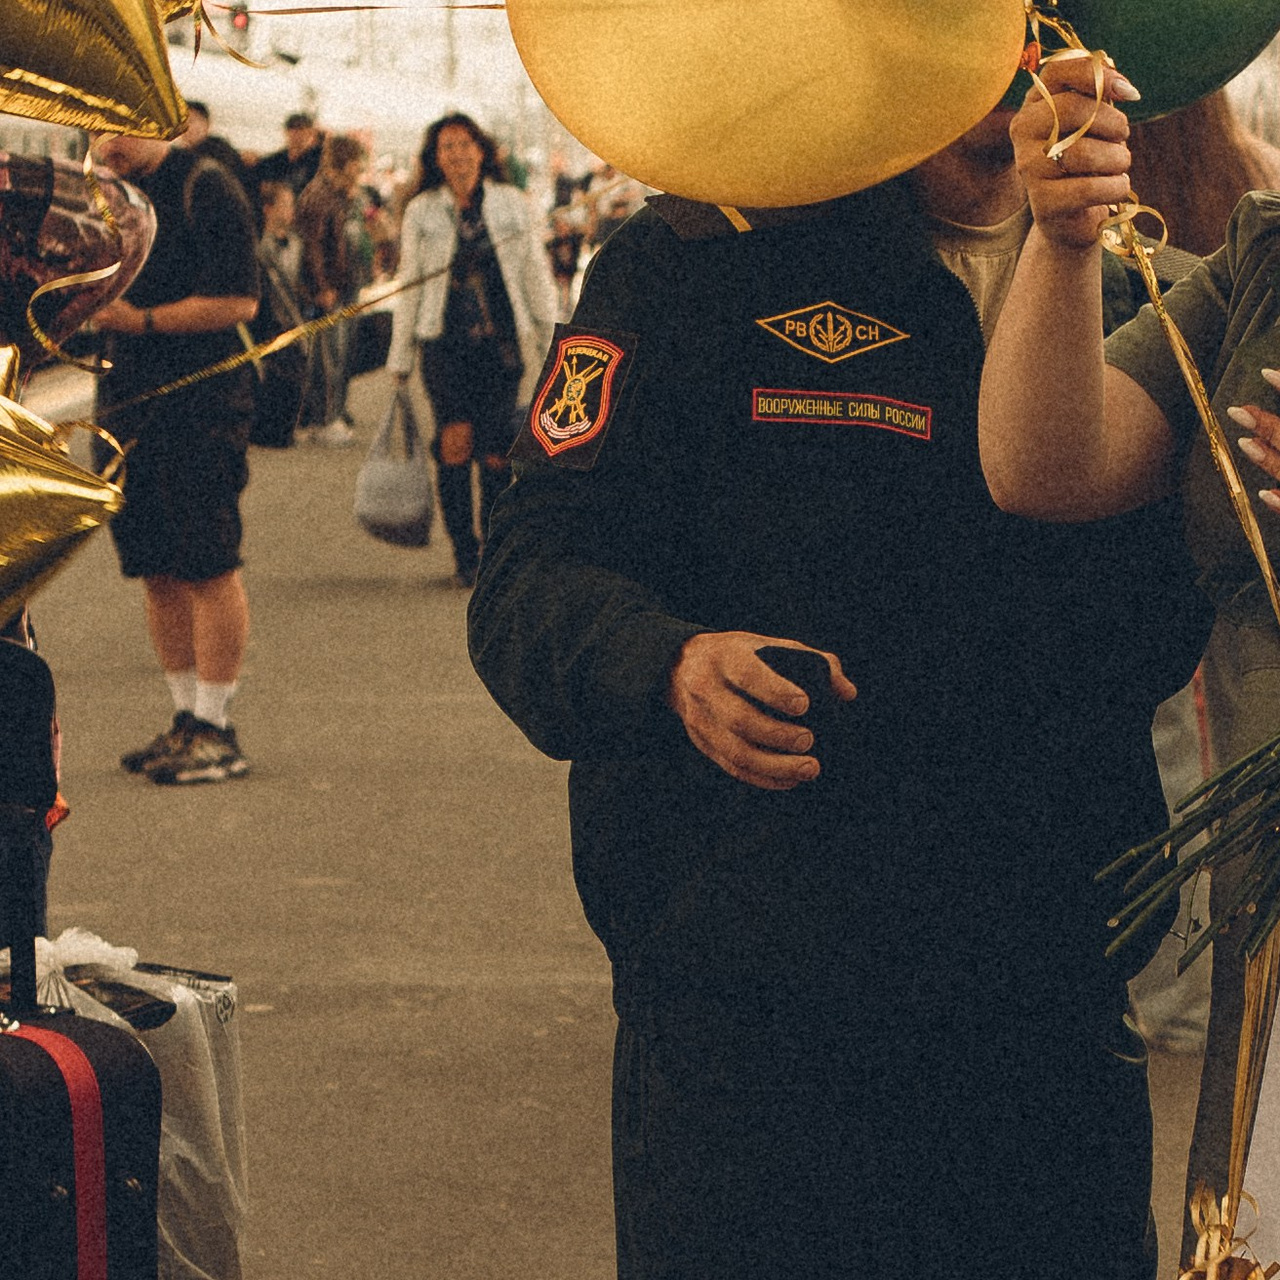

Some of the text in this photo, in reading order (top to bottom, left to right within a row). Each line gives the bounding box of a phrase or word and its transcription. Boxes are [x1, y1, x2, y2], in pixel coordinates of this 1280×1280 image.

[785, 320, 879, 341] РВ СН
[758, 397, 926, 431] ВООРУЖЕННЫЕ СИЛЫ РОССИИ
